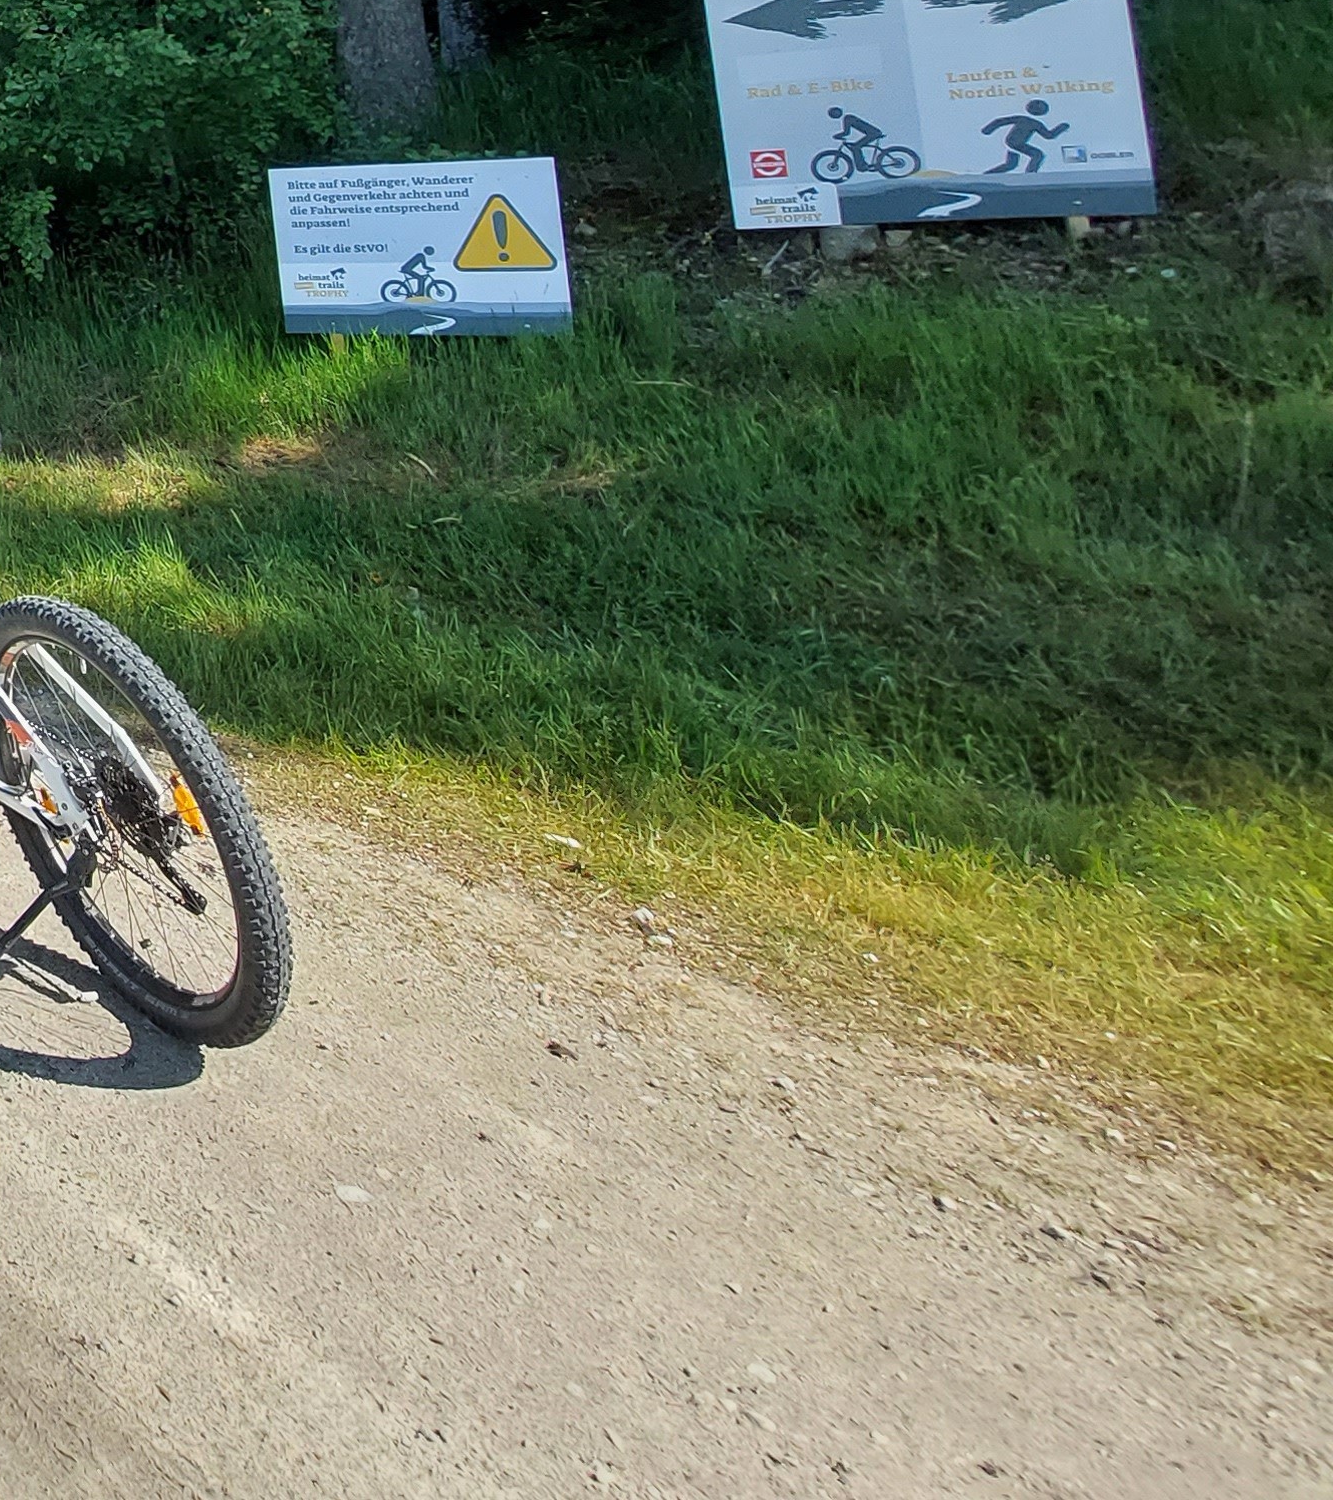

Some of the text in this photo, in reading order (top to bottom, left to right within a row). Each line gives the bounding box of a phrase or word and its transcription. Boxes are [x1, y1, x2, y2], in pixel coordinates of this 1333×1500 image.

[947, 66, 1038, 83] Laufen &
[747, 78, 874, 99] Rad & E-Bike
[949, 78, 1115, 100] Nordic Walking
[287, 175, 474, 190] Bitte auf Fußgänger, Wanderer
[288, 188, 470, 203] und Gegenverkehr achten und
[755, 196, 797, 205] heimat
[290, 201, 460, 215] die Fahrweise entsprechend
[781, 204, 817, 213] trails
[291, 218, 351, 230] anpassen!
[764, 213, 822, 223] TROPHY
[294, 243, 389, 256] Es gilt die StVO!
[298, 273, 331, 282] heimat
[318, 281, 345, 289] trails
[306, 290, 349, 298] TROPHY
